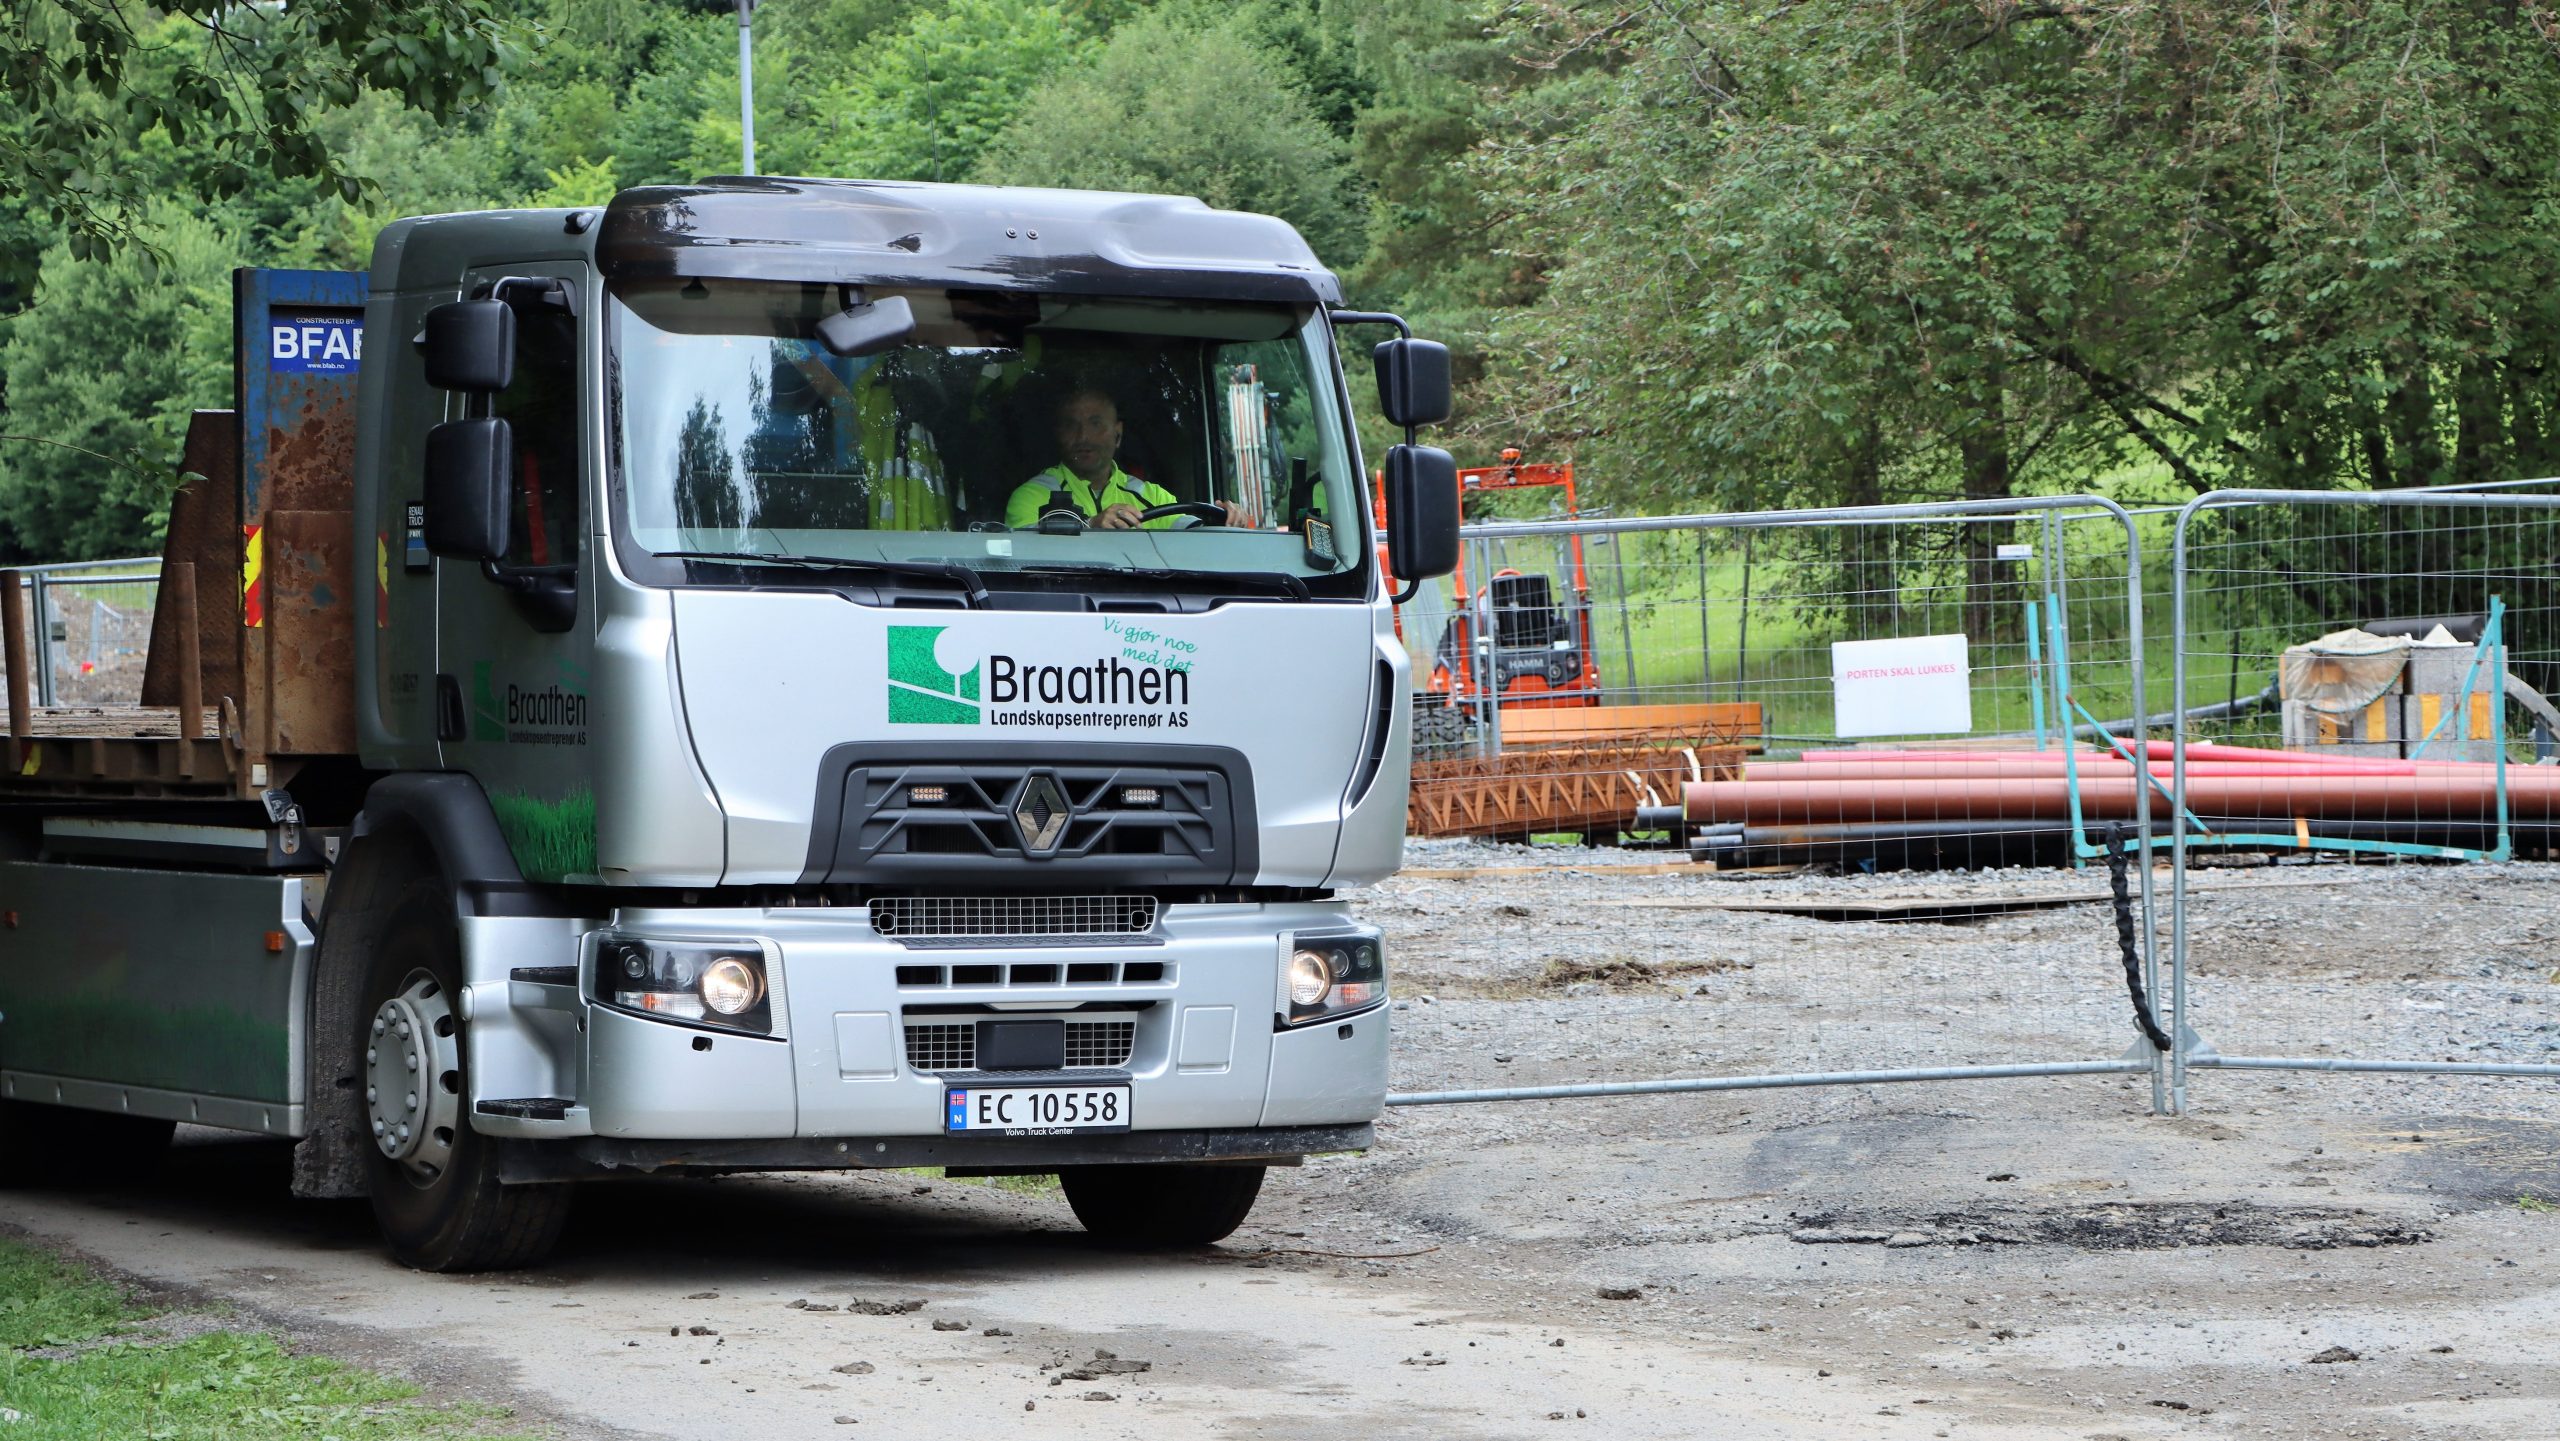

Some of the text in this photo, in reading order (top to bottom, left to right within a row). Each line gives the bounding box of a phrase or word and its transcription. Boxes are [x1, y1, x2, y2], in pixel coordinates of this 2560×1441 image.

[296, 317, 344, 325] CONSTRUCTED
[1104, 616, 1199, 653] Vi gjør noe
[1122, 647, 1195, 673] med det
[1509, 658, 1544, 668] HAMM
[990, 655, 1189, 705] Braathen
[1847, 664, 1956, 680] PORTEN SKAL LUKKES
[508, 683, 587, 726] Braathen
[991, 709, 1189, 730] Landskapsentreprenør AS
[577, 731, 587, 745] AS
[979, 1092, 1118, 1124] EC 10558
[953, 1114, 962, 1123] N
[1005, 1127, 1074, 1136] Volvo Truck Center
